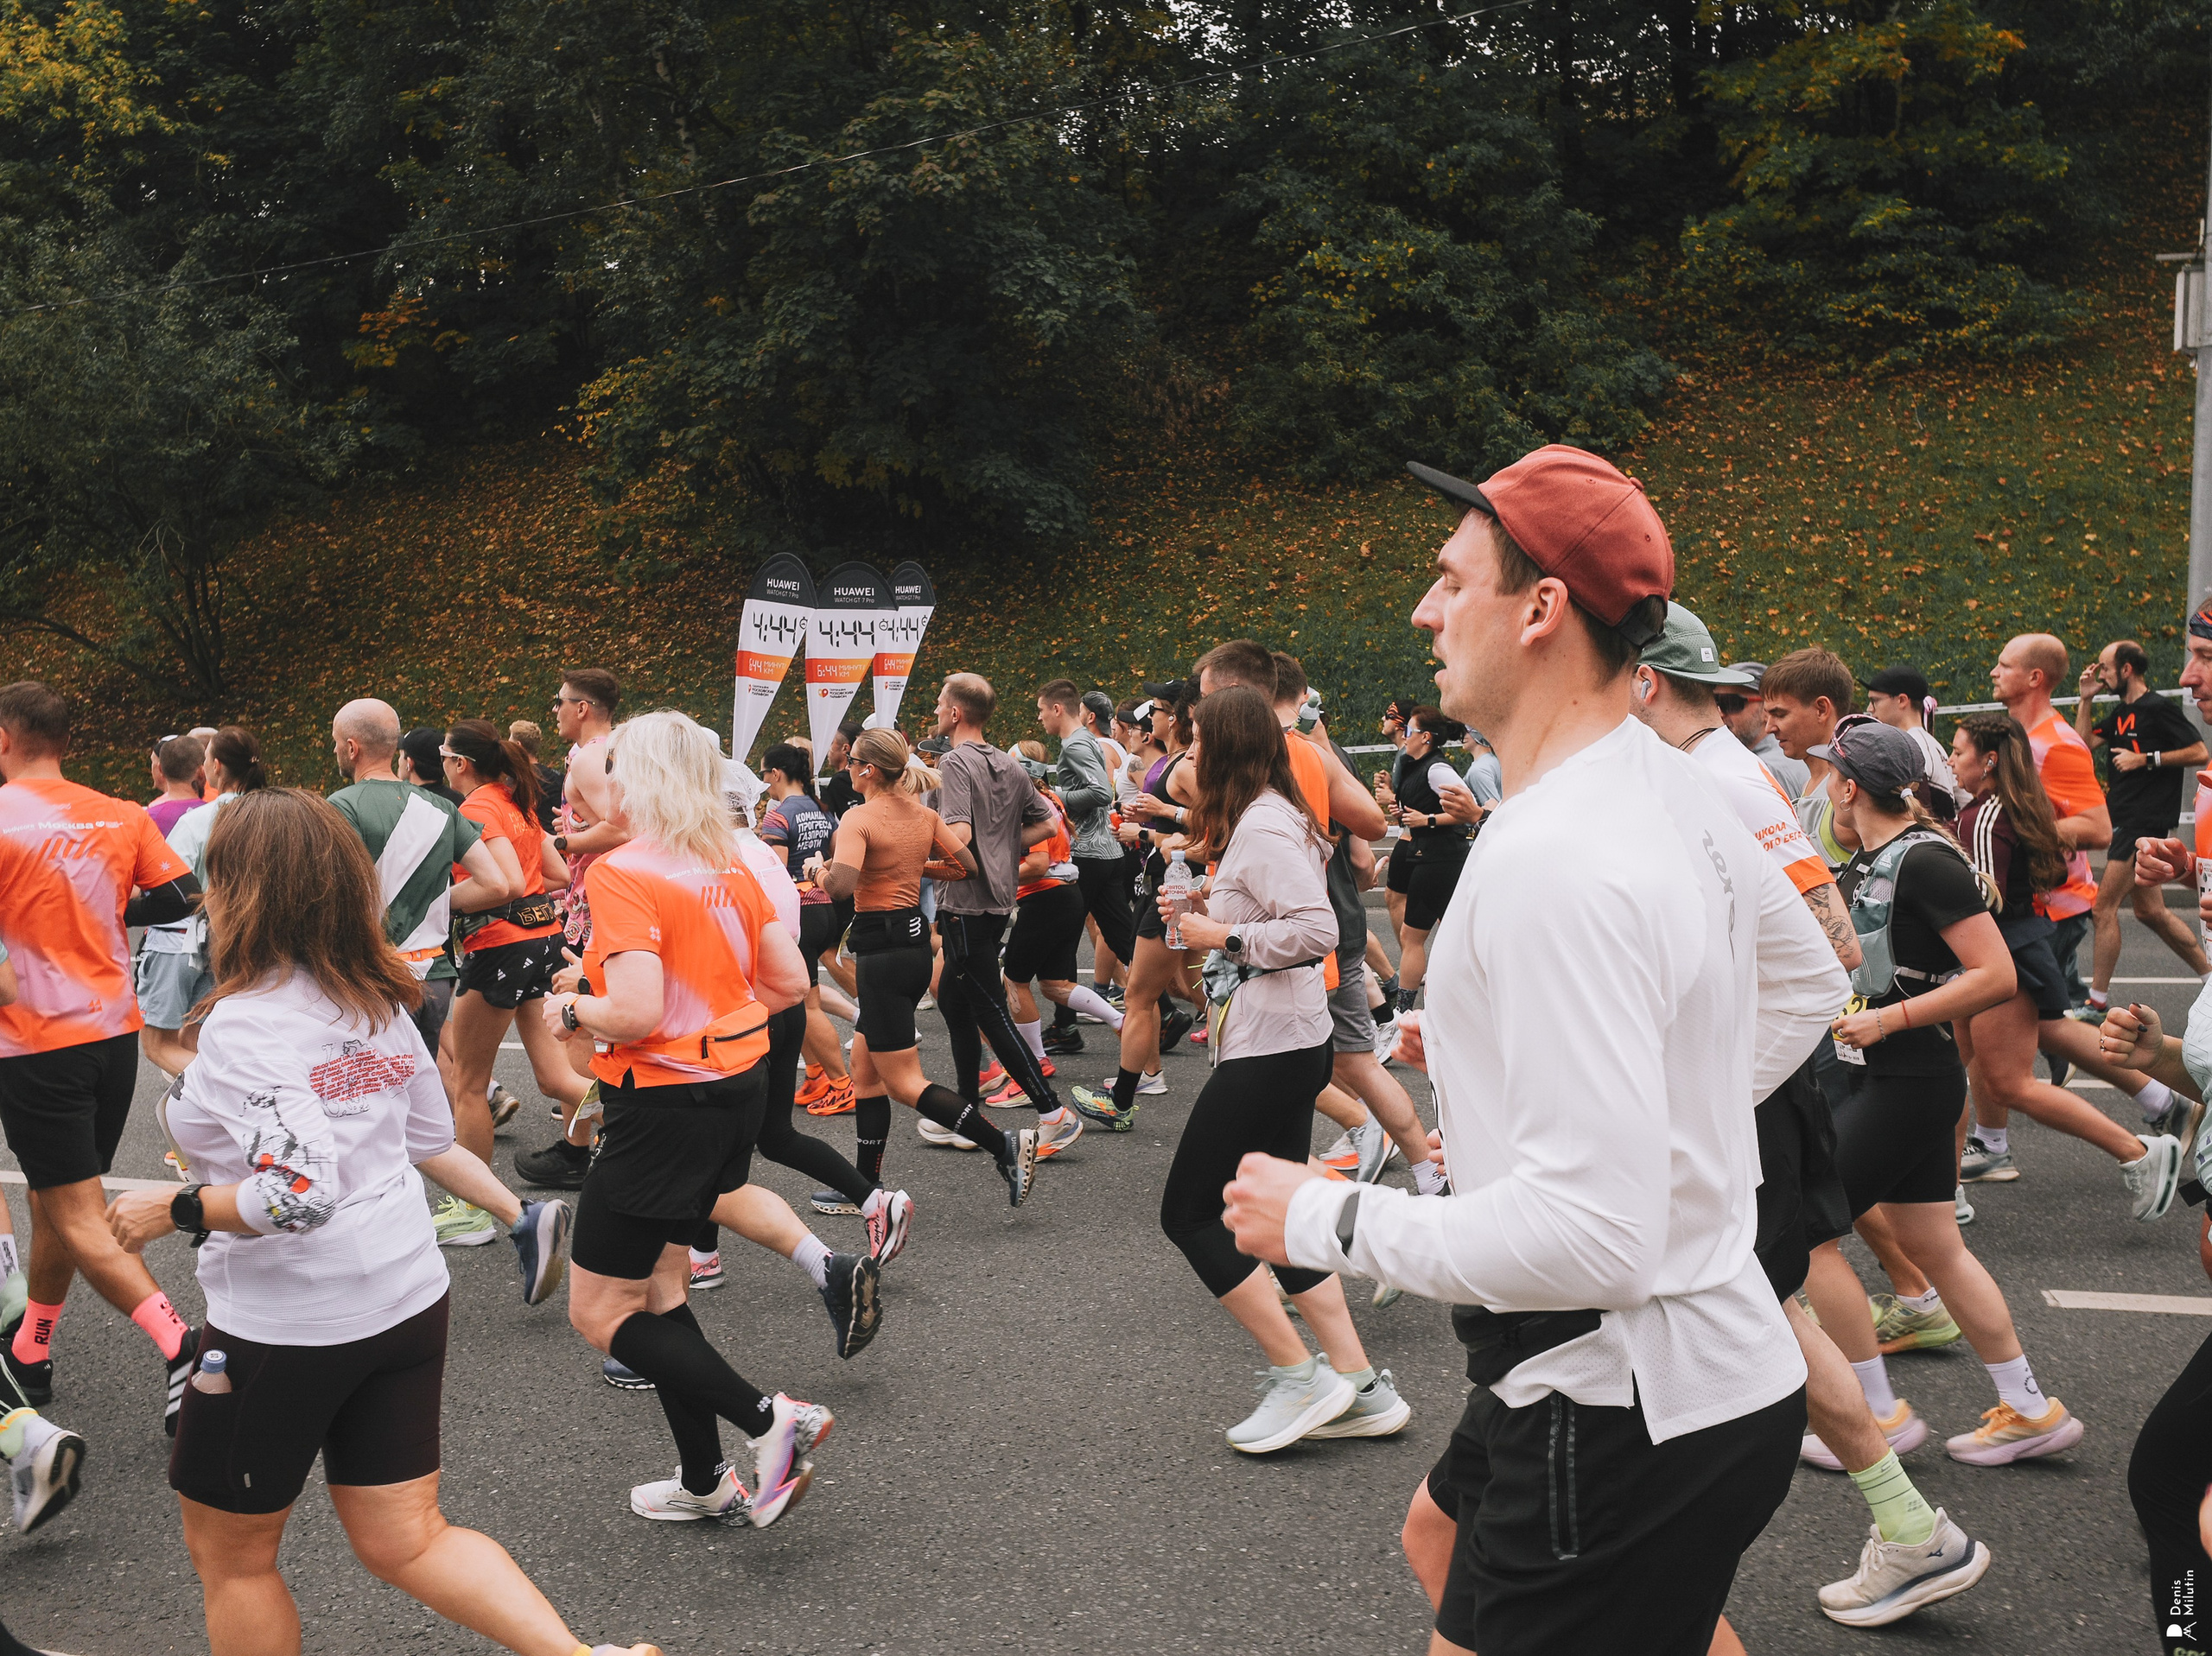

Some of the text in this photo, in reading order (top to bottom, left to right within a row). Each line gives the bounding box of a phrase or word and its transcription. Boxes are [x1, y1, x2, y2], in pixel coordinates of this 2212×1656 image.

[766, 578, 800, 591] HUAWEI
[895, 586, 922, 594] HUAWEI
[834, 587, 874, 596] HUAWEI
[753, 612, 798, 645] 4:44
[819, 619, 874, 647] 4:44
[817, 664, 837, 677] 6:44
[796, 811, 826, 823] КОМАНДА
[798, 830, 829, 842] ГАЗПРОМ
[1755, 822, 1786, 841] ШКОЛА
[797, 840, 822, 851] НЕФТИ
[1763, 831, 1802, 851] ОГО БЕГА
[35, 1318, 53, 1345] RUN
